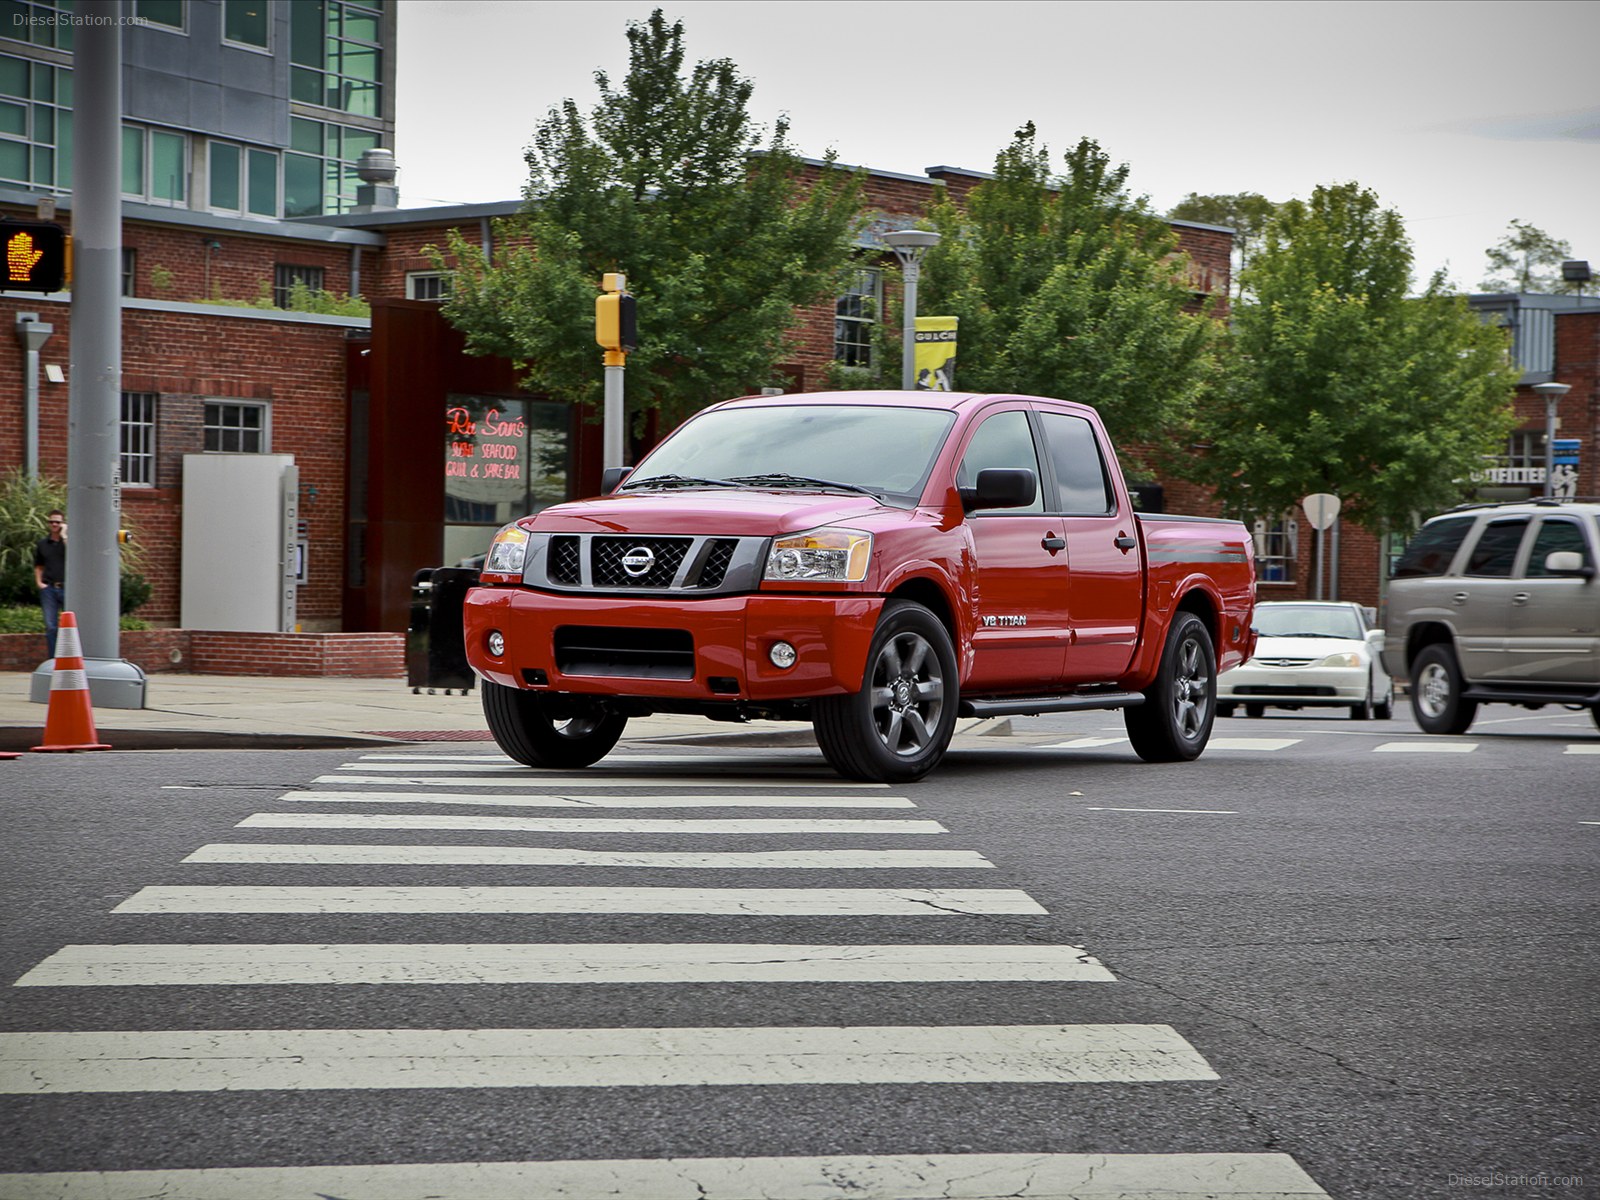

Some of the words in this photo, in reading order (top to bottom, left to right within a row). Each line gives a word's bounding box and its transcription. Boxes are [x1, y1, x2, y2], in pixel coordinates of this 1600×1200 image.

[915, 331, 957, 341] GULCH
[481, 443, 517, 460] SEAFOOD
[470, 463, 480, 478] &
[503, 463, 520, 479] BAR
[982, 615, 997, 627] V8
[998, 615, 1027, 627] TITAN
